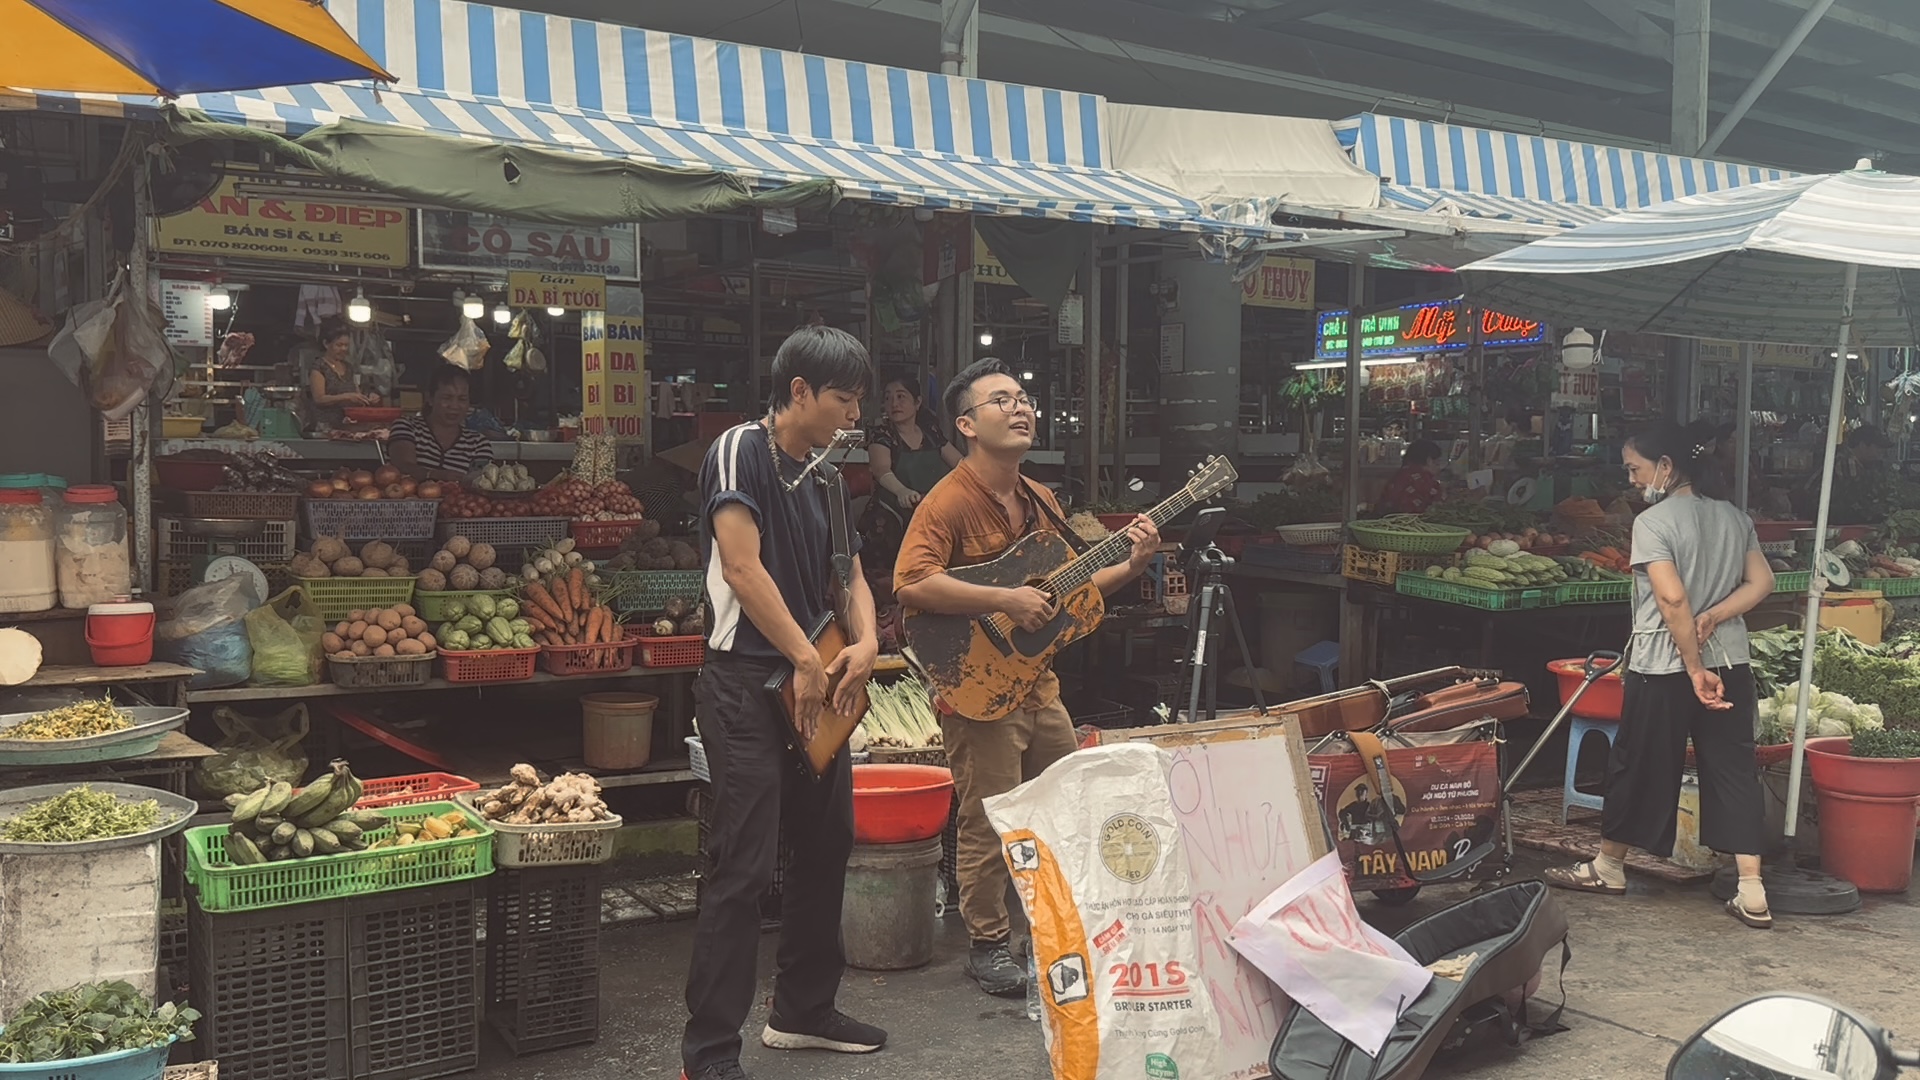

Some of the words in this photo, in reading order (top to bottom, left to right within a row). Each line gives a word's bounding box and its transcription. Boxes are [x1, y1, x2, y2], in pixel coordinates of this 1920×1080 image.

[258, 200, 296, 221] &
[224, 223, 268, 239] BÁN
[297, 230, 314, 242] &
[528, 229, 610, 262] SÁU
[515, 288, 538, 304] DA
[607, 321, 642, 341] BÁN
[585, 352, 600, 372] DA
[610, 352, 636, 372] DA
[614, 382, 635, 404] BÌ
[1104, 818, 1125, 842] GOLD
[1127, 818, 1152, 839] COIN
[1358, 849, 1398, 876] TÂY
[1114, 1000, 1146, 1012] BRLER
[1148, 999, 1193, 1012] STARTER
